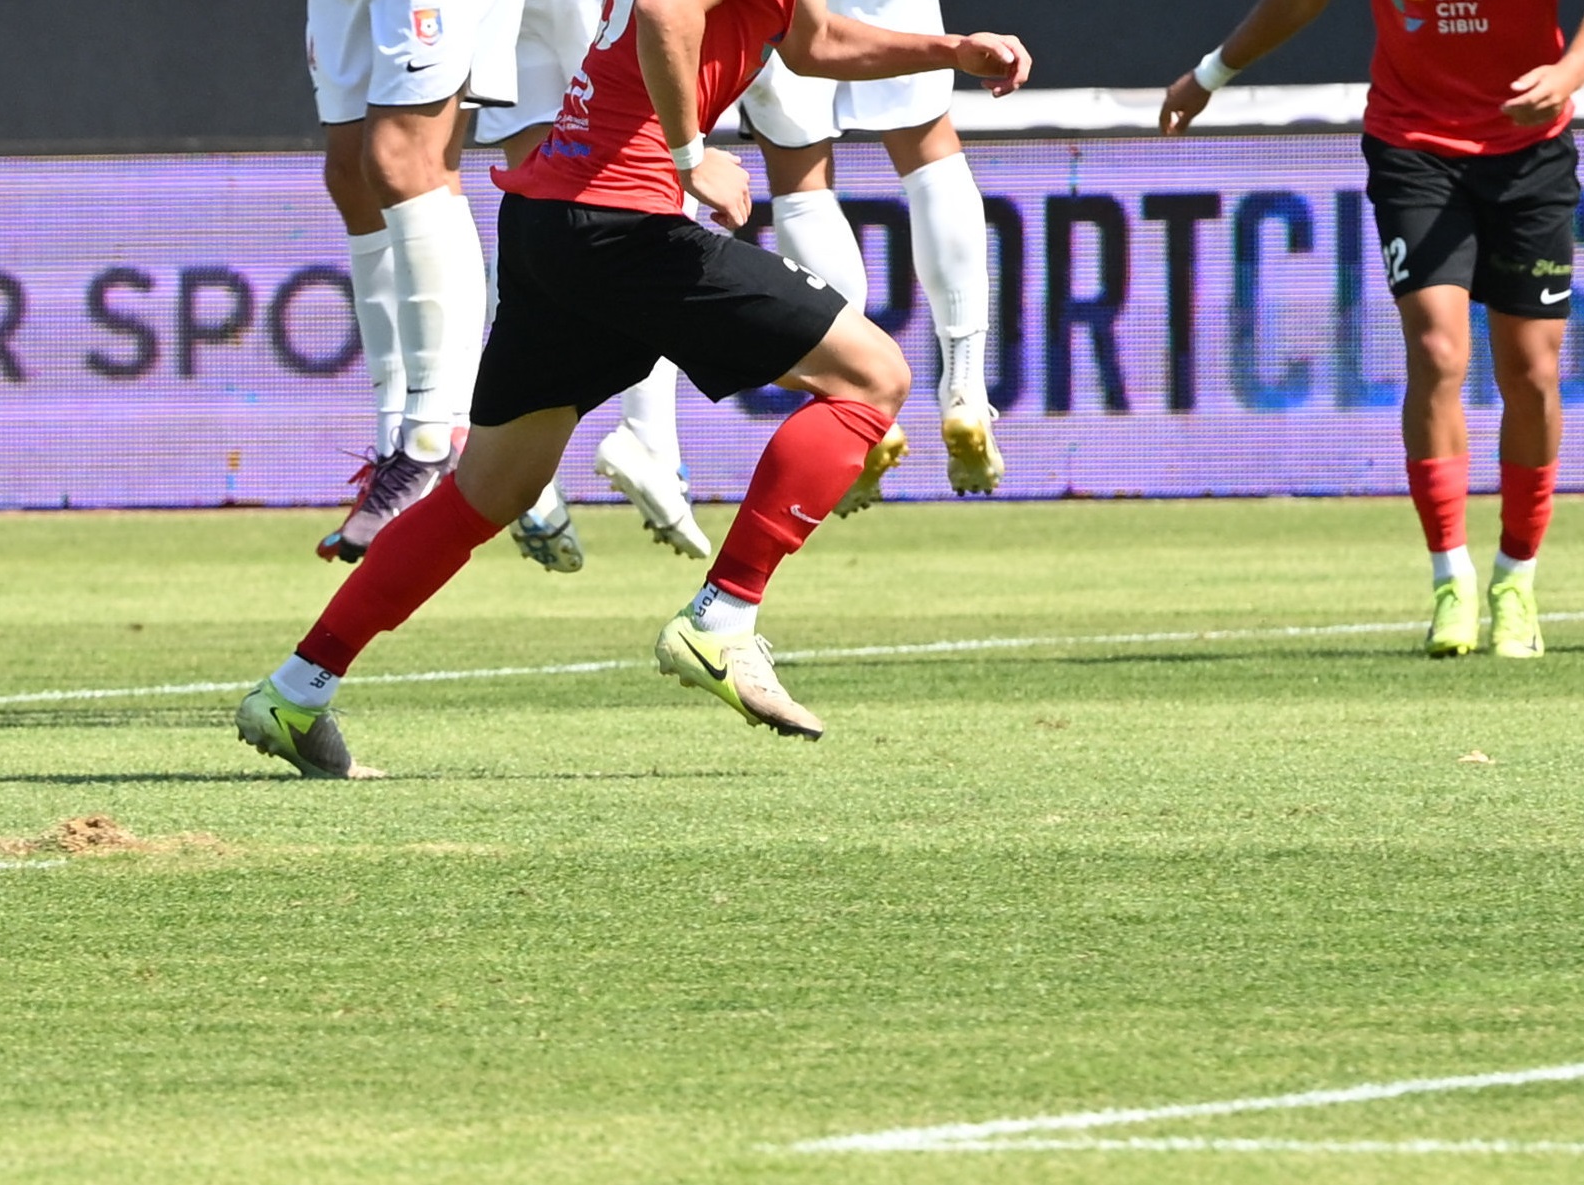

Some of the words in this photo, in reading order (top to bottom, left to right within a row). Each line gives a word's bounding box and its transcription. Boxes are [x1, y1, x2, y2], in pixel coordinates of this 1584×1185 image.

[1436, 2, 1479, 18] CITY
[1437, 18, 1489, 35] SIBIU
[85, 265, 367, 380] SPO
